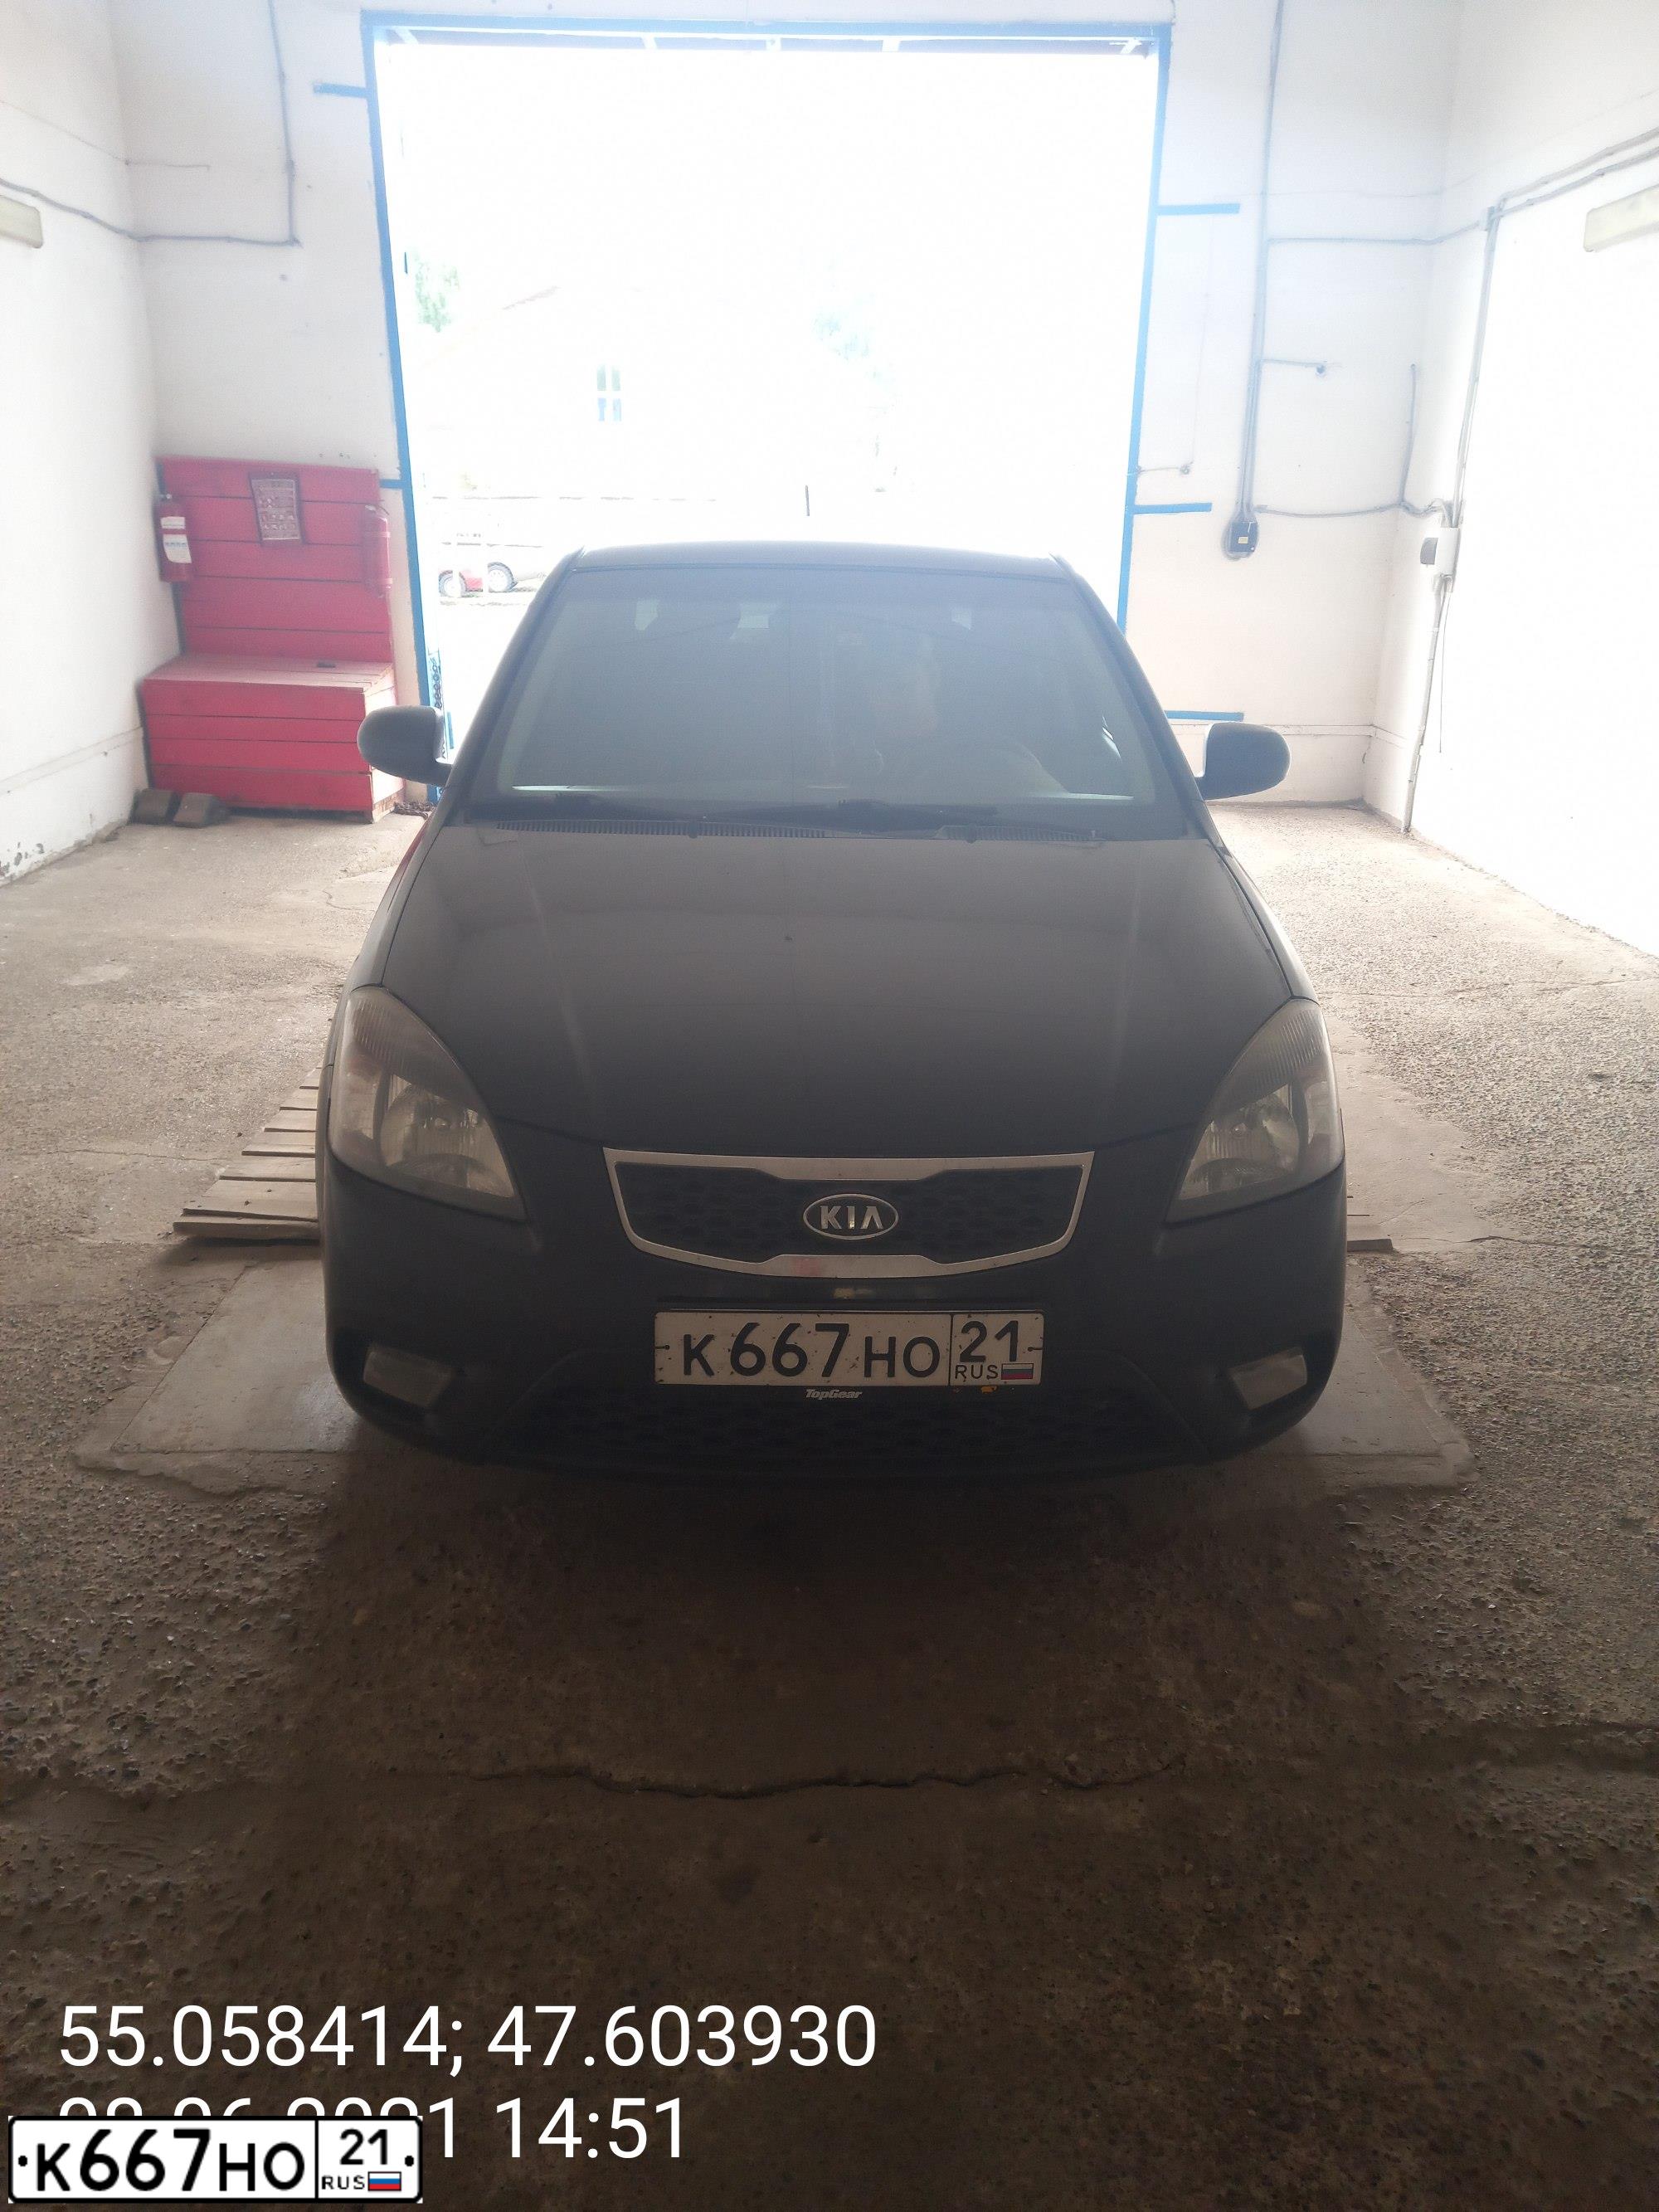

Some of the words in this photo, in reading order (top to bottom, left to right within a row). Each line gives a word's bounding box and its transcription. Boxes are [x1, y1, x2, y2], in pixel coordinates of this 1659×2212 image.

[820, 1205, 883, 1230] KIA
[958, 1320, 1019, 1363] 21
[954, 1363, 999, 1381] RUS
[805, 1388, 863, 1401] TopGear
